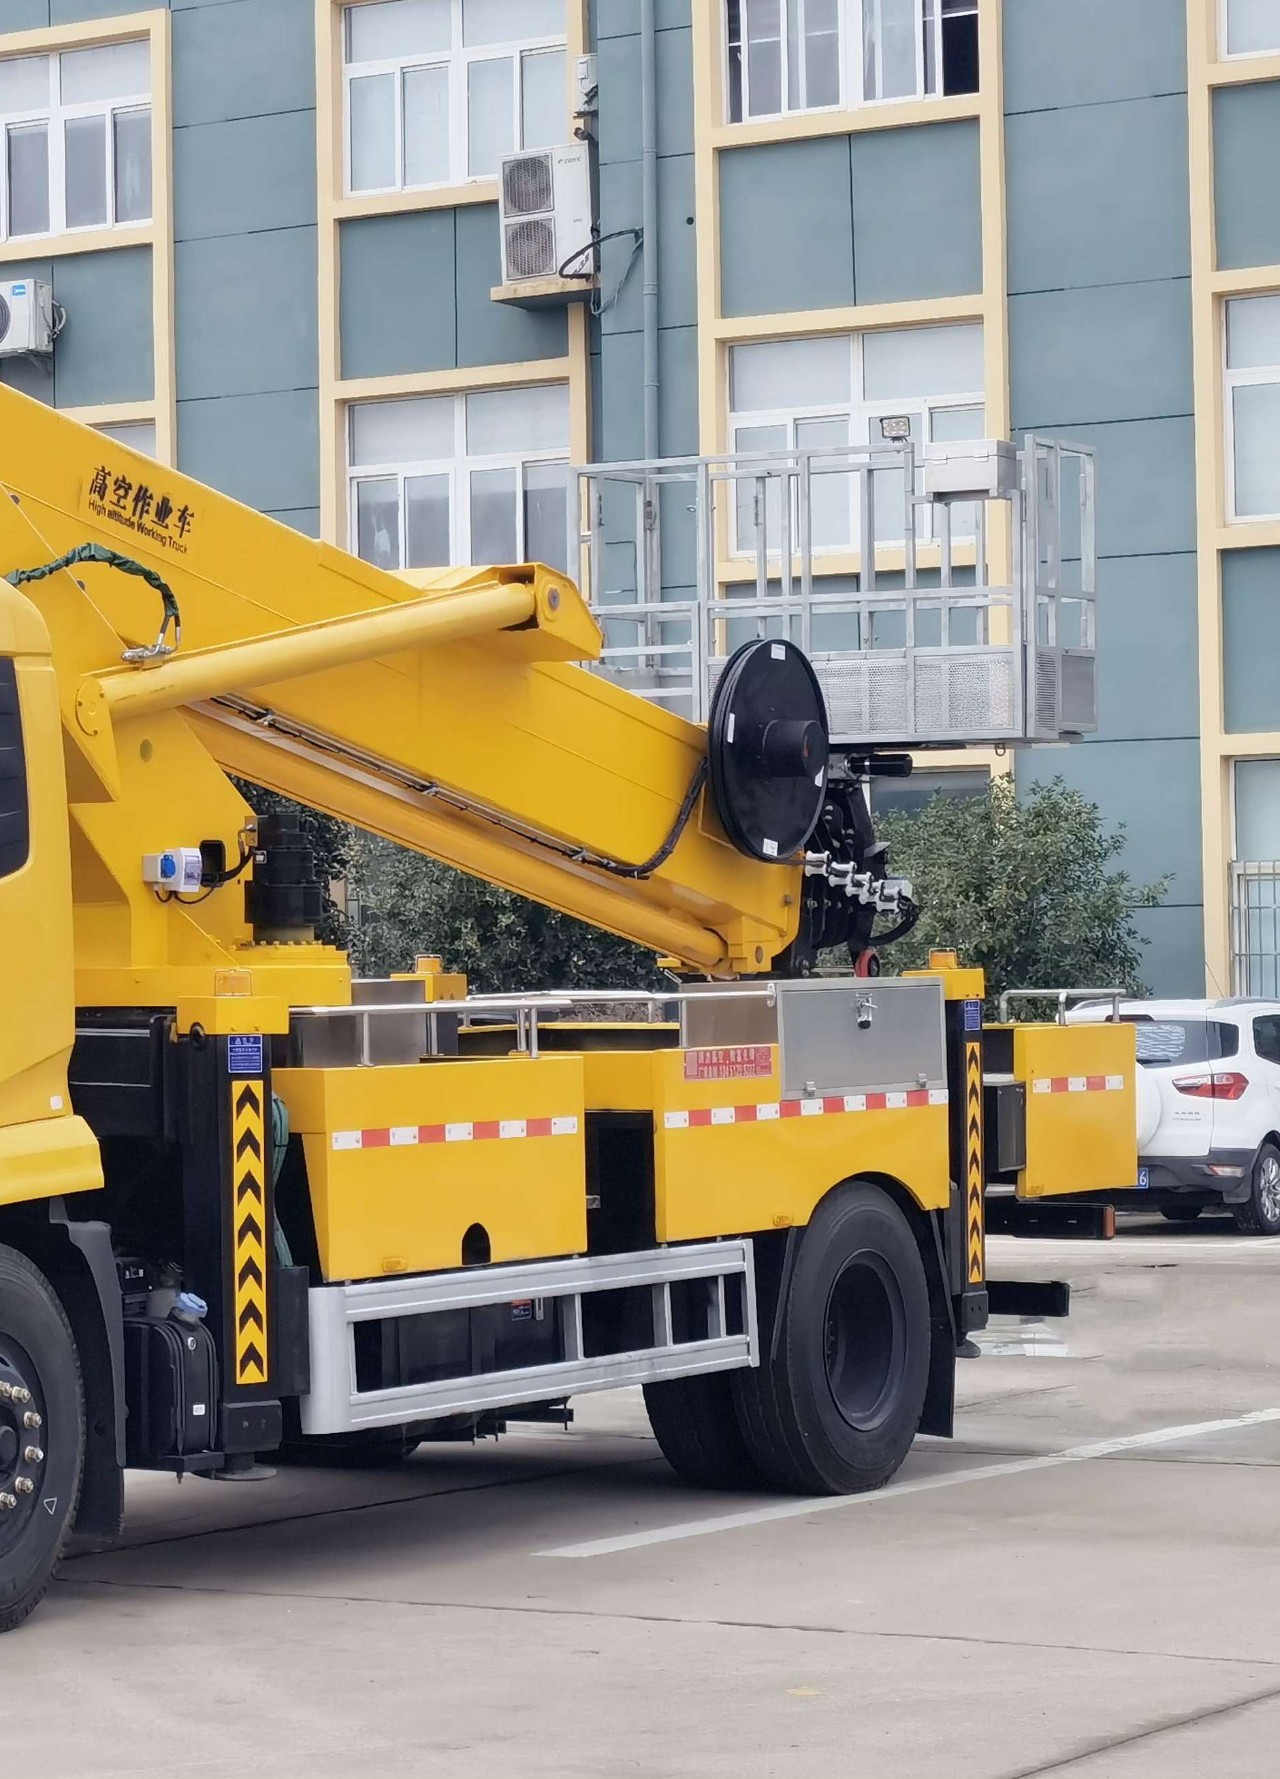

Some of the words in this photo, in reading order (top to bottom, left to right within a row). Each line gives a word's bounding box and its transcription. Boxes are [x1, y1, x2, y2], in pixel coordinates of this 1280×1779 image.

[88, 499, 106, 517] High
[136, 520, 167, 548] Working
[167, 535, 188, 555] Truck
[89, 465, 195, 539] 高空作业车
